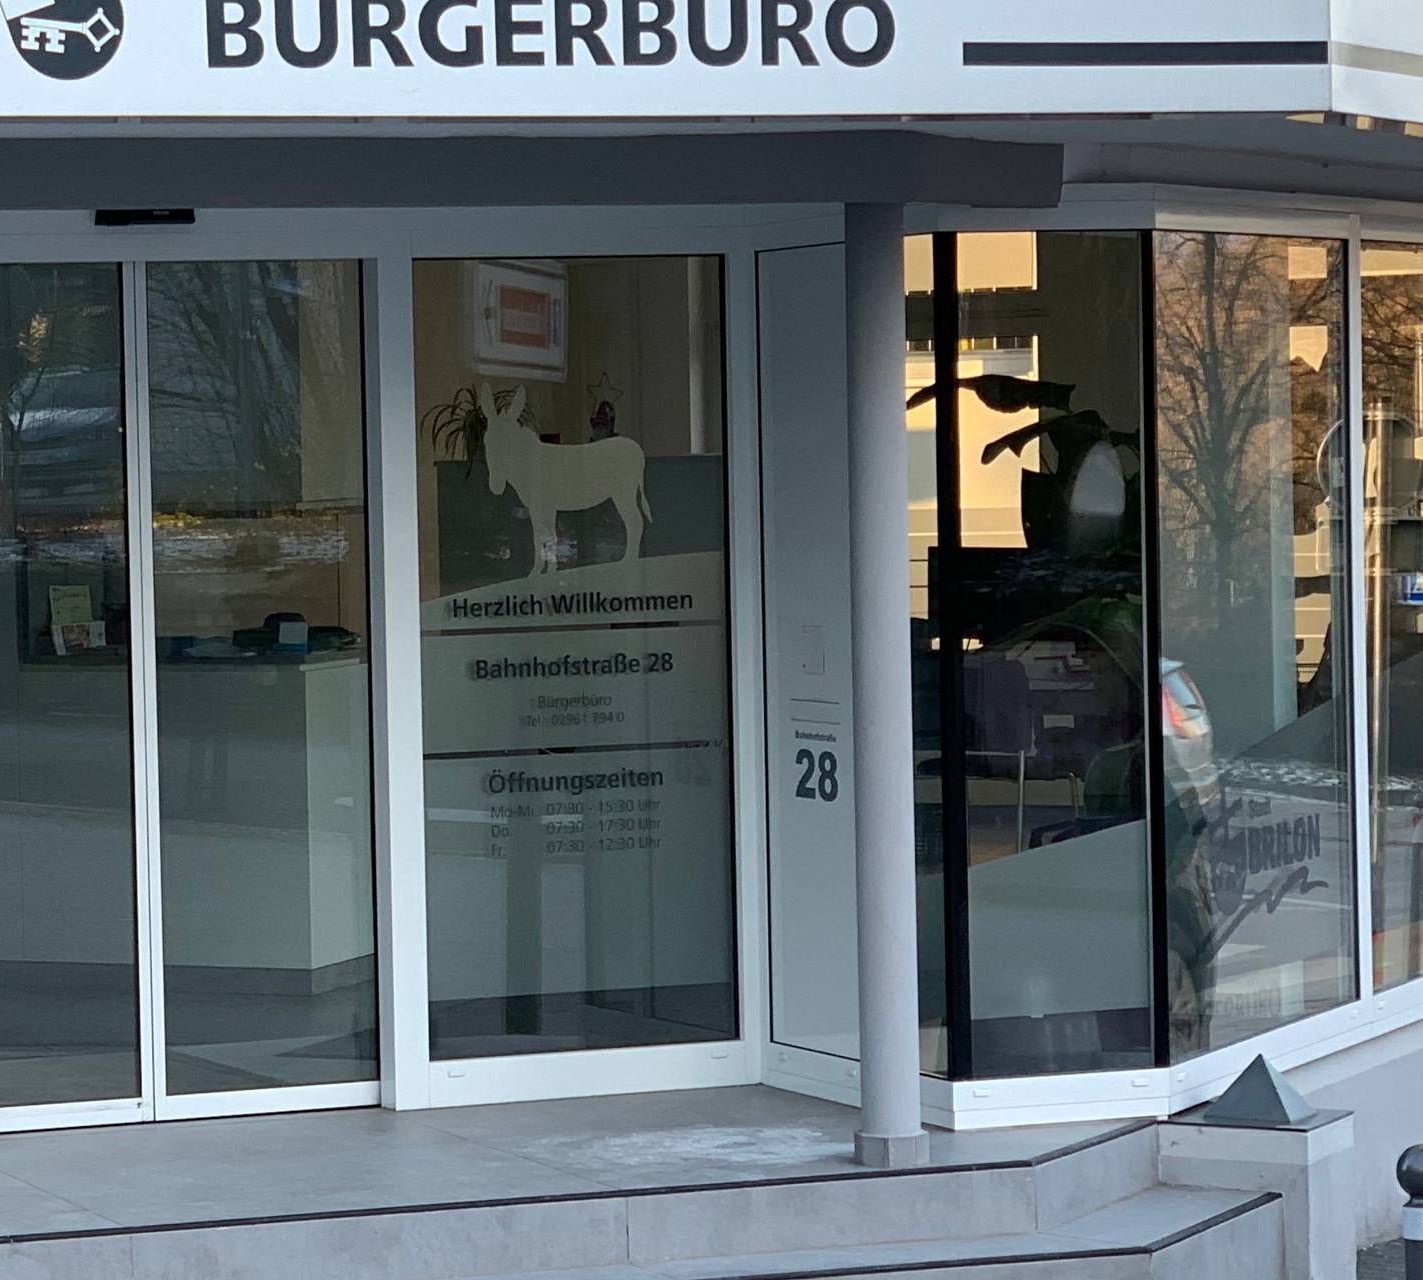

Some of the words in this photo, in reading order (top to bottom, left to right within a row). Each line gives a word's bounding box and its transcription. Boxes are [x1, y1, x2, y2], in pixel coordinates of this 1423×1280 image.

[452, 595, 544, 618] Herzlich
[551, 592, 693, 615] Willkommen
[475, 654, 640, 679] Bahnhofstraße
[647, 652, 674, 673] 28
[537, 692, 612, 711] Bürgerbüro
[488, 769, 664, 795] Öffnungszeiten
[795, 748, 839, 802] 28
[638, 799, 660, 812] Uhr
[639, 818, 660, 831] Uhr
[639, 836, 661, 849] Uhr
[1248, 813, 1321, 874] BRILON
